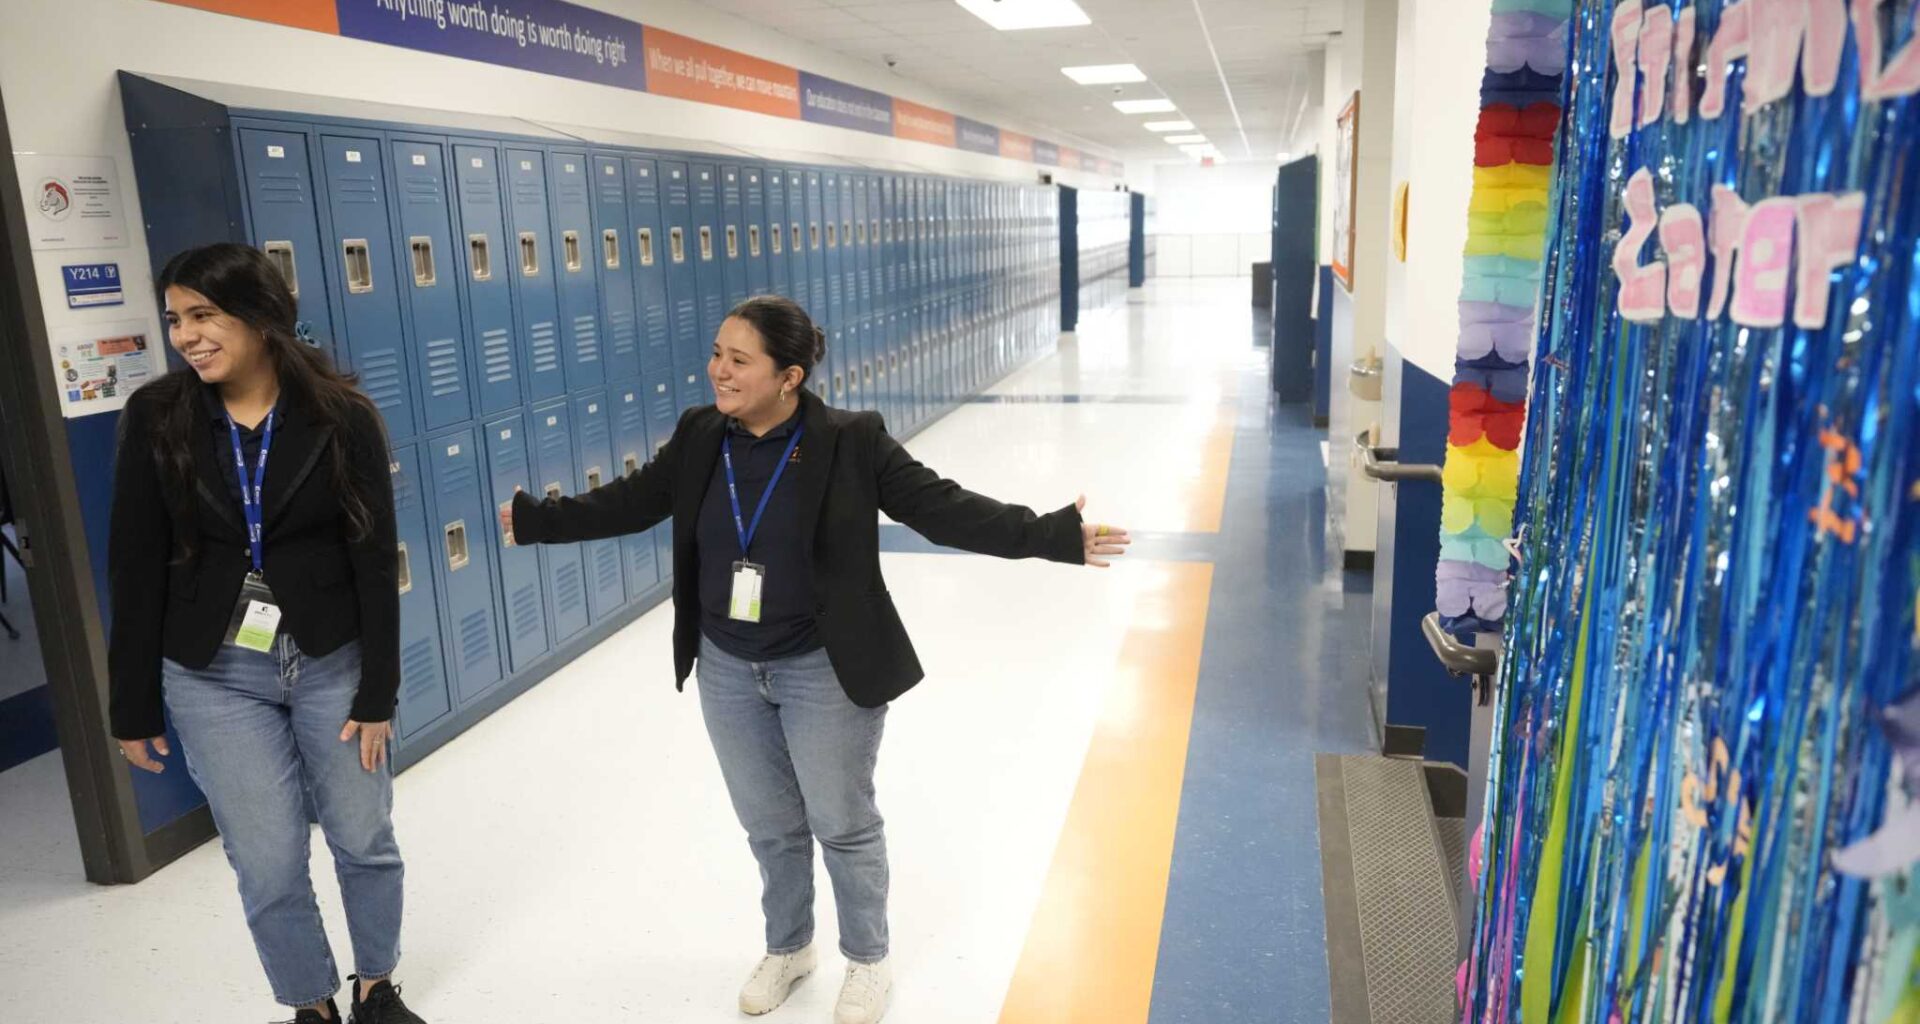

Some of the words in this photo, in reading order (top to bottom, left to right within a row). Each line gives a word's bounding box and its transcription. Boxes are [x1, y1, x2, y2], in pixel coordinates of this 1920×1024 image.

[447, 1, 488, 32] worth
[491, 4, 526, 47] doing
[527, 14, 537, 43] is
[538, 23, 572, 51] worth
[574, 27, 603, 63] doing
[604, 35, 627, 67] right
[648, 48, 673, 73] When
[674, 58, 685, 76] we
[686, 56, 694, 78] all
[69, 267, 100, 280] Y214
